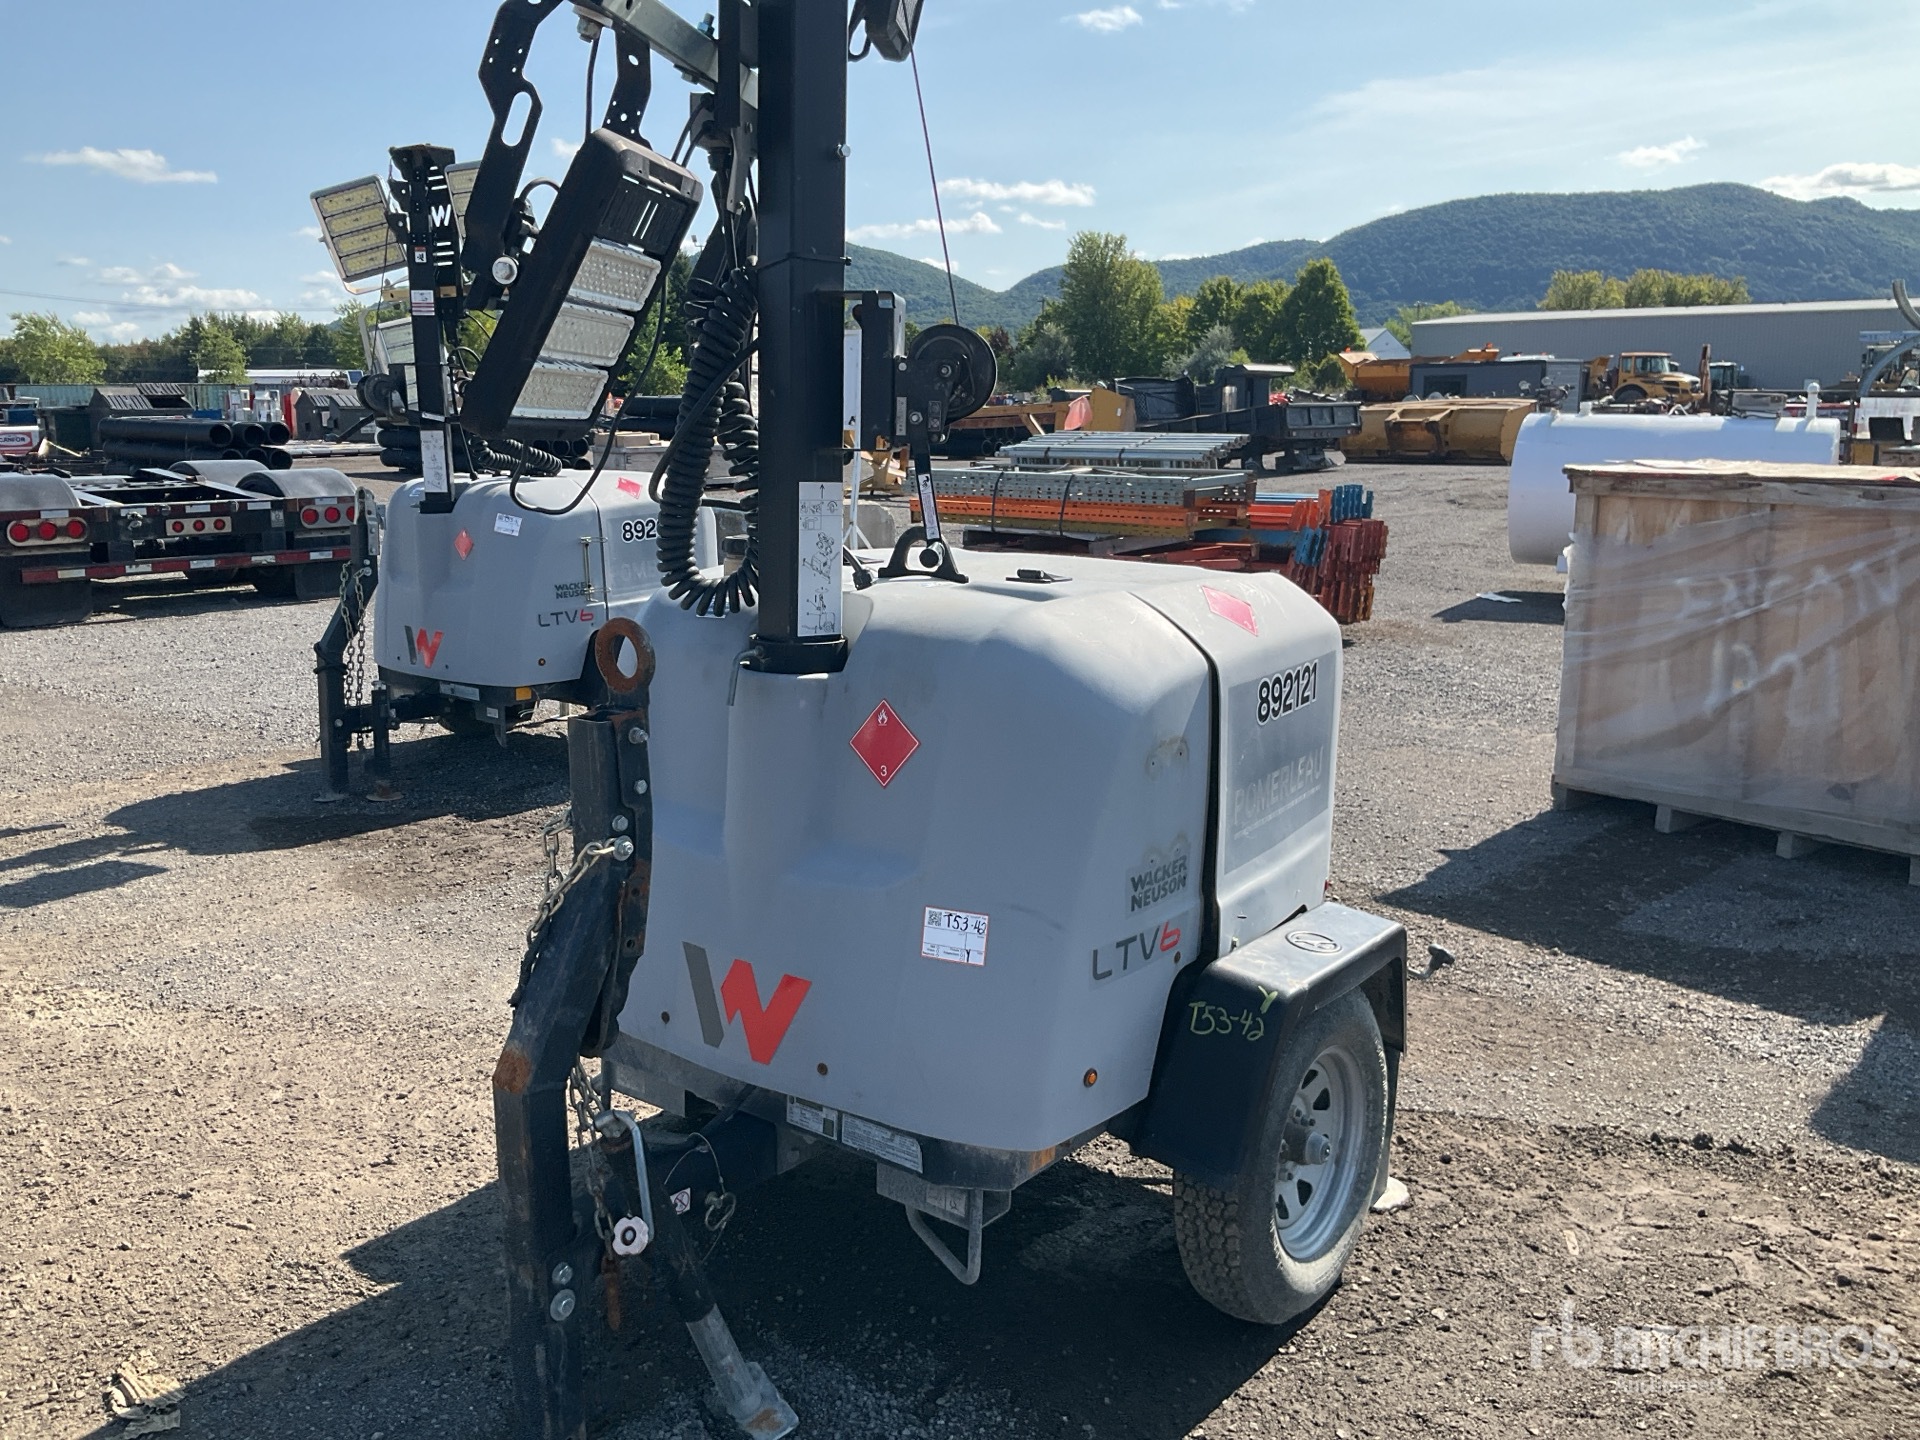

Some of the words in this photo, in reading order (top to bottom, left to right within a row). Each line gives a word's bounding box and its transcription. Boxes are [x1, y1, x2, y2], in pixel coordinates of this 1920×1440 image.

[622, 519, 658, 543] 892
[554, 582, 587, 592] WACKE
[555, 590, 587, 600] NEUSO
[538, 608, 594, 628] LTV6
[1257, 660, 1318, 725] 892121
[880, 765, 888, 777] 3
[1233, 746, 1324, 825] POMERLEAU
[1130, 855, 1188, 893] WACKER
[1130, 873, 1188, 912] NEUSON
[1092, 920, 1181, 981] LTV6
[1188, 1000, 1265, 1042] T53-42
